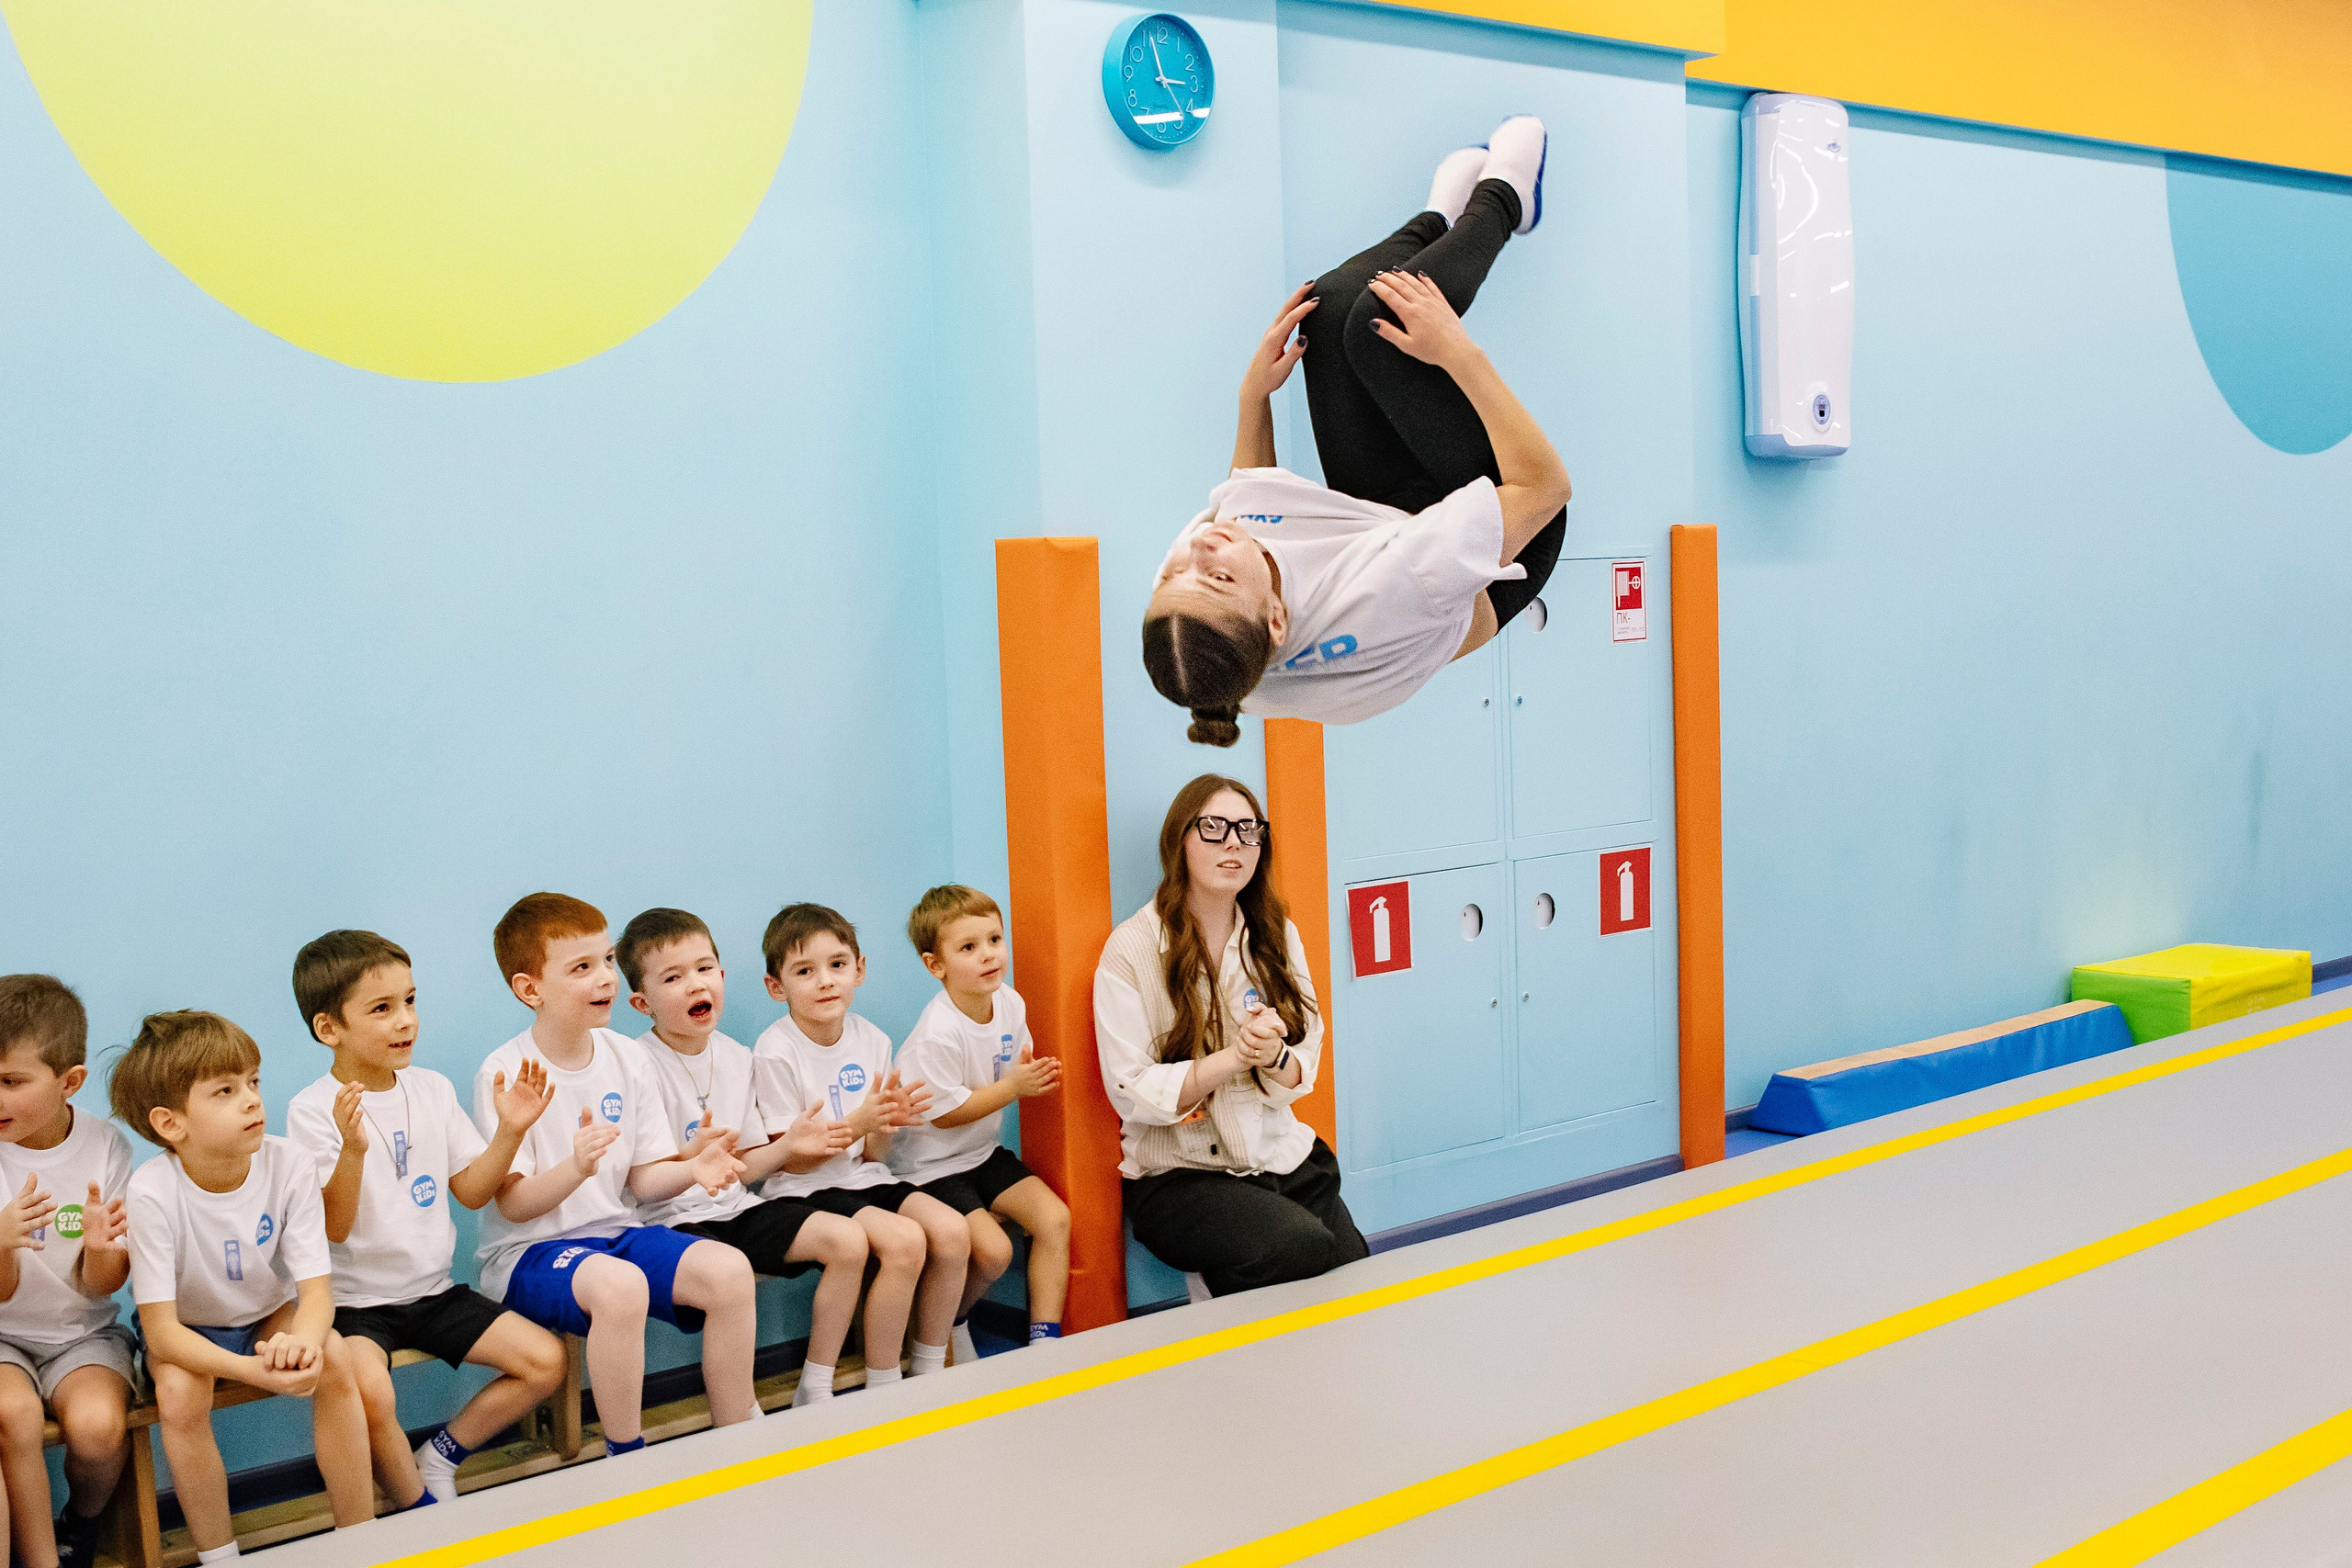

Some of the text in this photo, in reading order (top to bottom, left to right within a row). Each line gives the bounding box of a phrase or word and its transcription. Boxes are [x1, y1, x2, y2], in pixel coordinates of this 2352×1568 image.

[1156, 26, 1169, 45] 12
[1129, 44, 1144, 62] 10
[1184, 53, 1195, 72] 2
[1123, 64, 1135, 84] 9
[1189, 74, 1199, 93] 3
[1127, 88, 1138, 107] 8
[1185, 97, 1194, 114] 4
[840, 1068, 864, 1079] GYM
[413, 1179, 435, 1195] GYM
[58, 1221, 83, 1232] KiD
